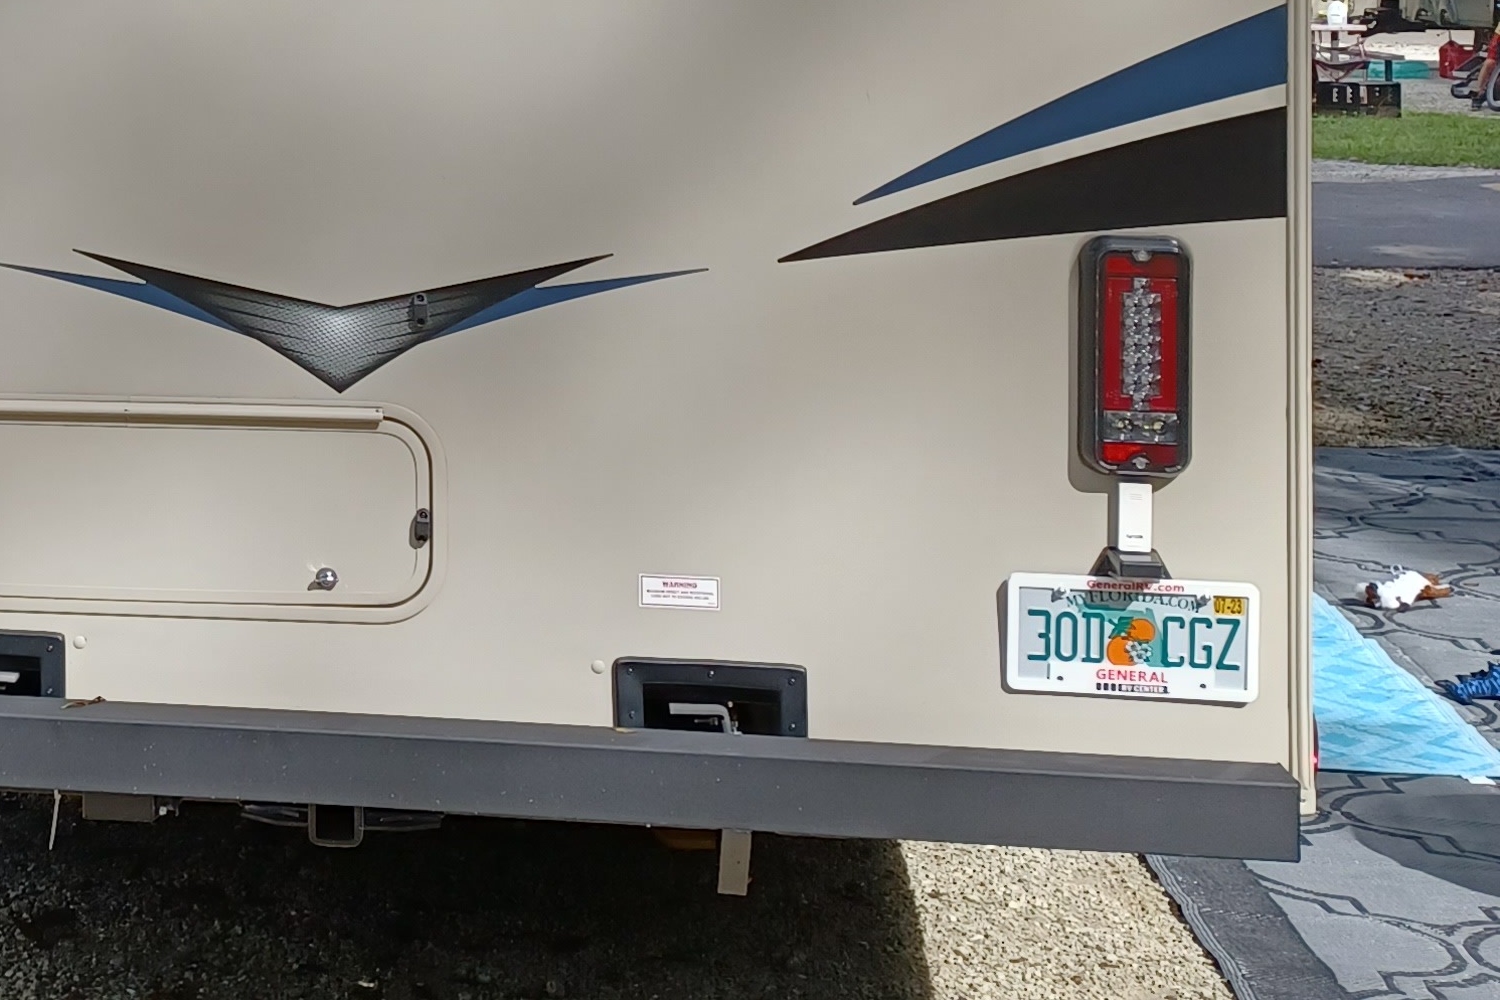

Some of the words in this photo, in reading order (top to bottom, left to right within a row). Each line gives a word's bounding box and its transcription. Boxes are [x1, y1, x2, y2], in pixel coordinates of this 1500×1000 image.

[662, 581, 698, 589] WARNING
[1086, 579, 1185, 593] GeneralRV.com
[1214, 597, 1242, 614] 07-23
[1162, 616, 1241, 670] CGZ
[1096, 668, 1169, 684] GENERAL
